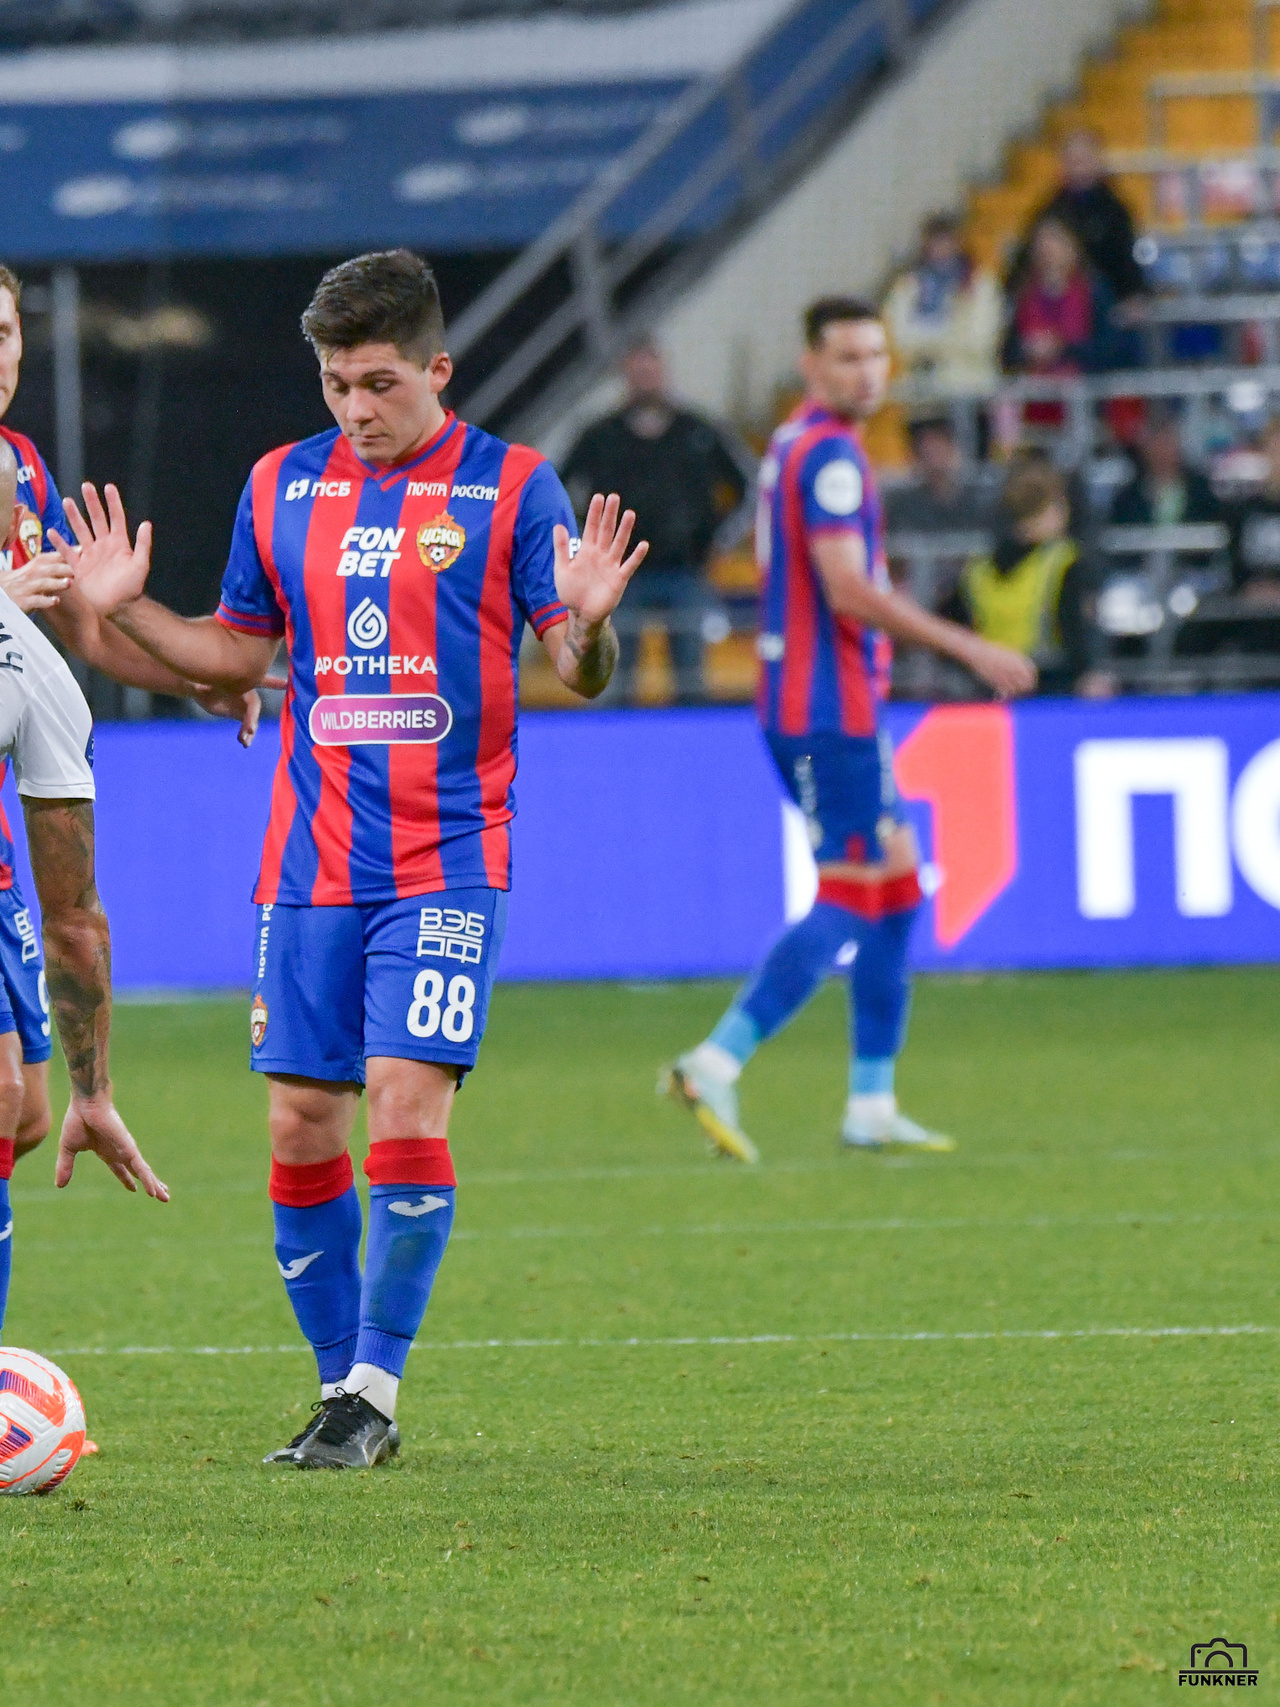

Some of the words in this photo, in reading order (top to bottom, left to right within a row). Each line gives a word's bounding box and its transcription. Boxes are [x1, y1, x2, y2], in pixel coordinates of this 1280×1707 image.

[310, 480, 351, 499] ПСБ
[406, 481, 447, 498] ПОЧТА
[451, 484, 499, 501] РОССИИ
[340, 526, 405, 550] FON
[336, 551, 401, 578] BET
[313, 655, 438, 676] APOTHEKA
[320, 709, 437, 731] WILDBERRIES
[420, 908, 485, 937] ВЭБ
[258, 926, 269, 978] ПОЧТА
[406, 968, 476, 1043] 88
